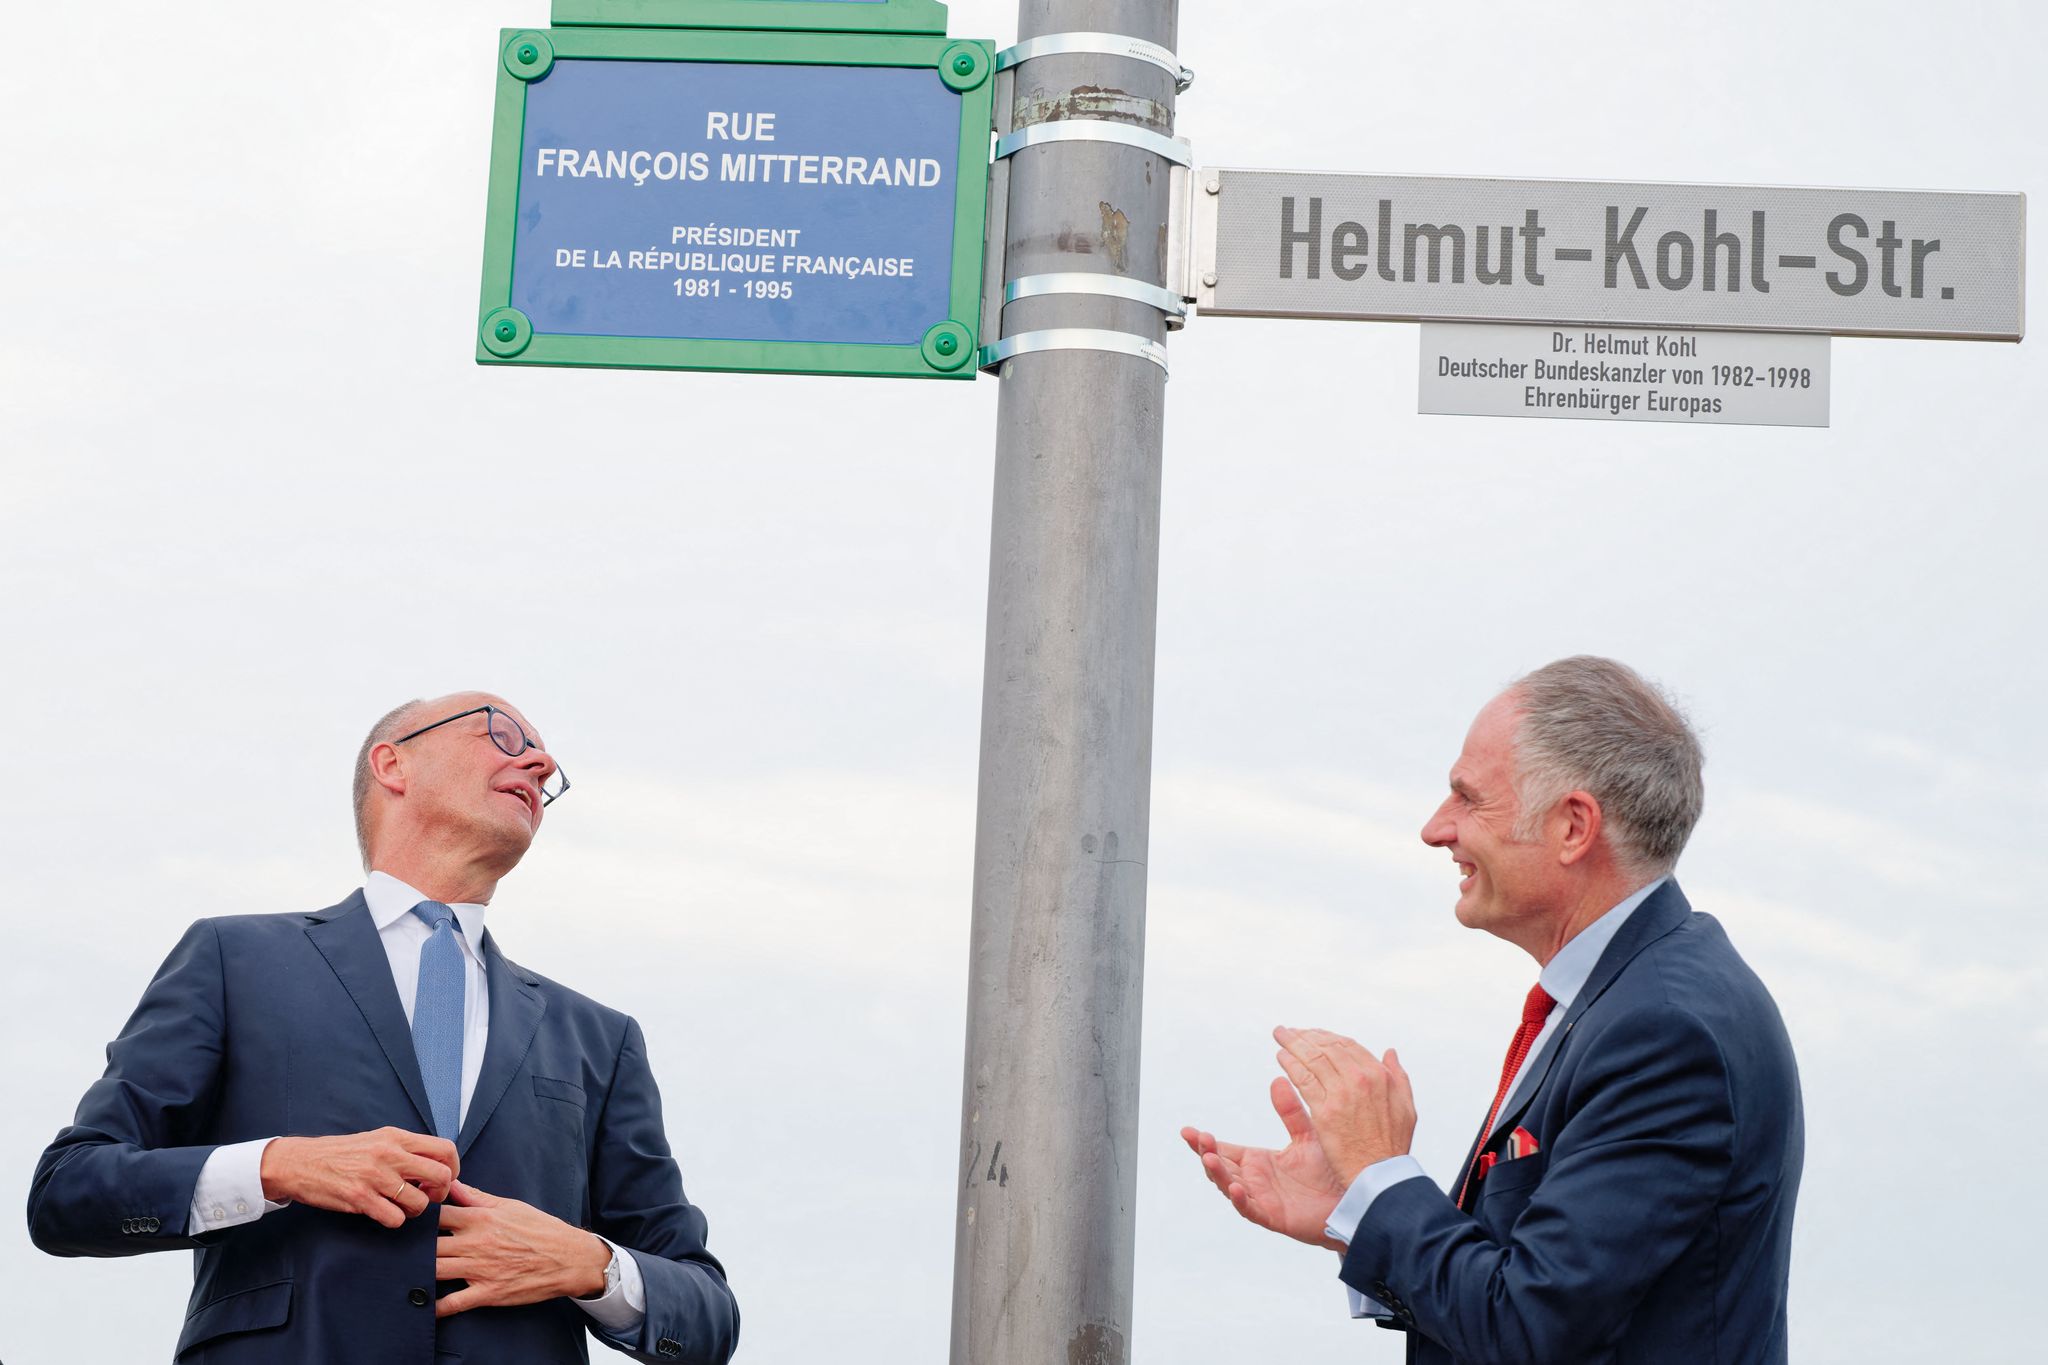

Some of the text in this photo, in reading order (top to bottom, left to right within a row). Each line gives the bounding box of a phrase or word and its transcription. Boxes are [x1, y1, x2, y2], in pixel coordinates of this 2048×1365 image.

[706, 111, 776, 142] RUE
[537, 148, 942, 187] FRANÇOIS MITTERRAND
[671, 223, 801, 248] PRÉSIDENT
[1279, 196, 1955, 301] Helmut-Kohl-Str.
[555, 247, 914, 280] DE LA RÉPUBLIQUE FRANÇAISE
[672, 278, 721, 298] 1981
[742, 280, 793, 300] 1995
[1552, 331, 1697, 358] Dr. Helmut Kohl
[1438, 355, 1811, 389] Deutscher Bundeskanzler von 1982-1998
[1525, 385, 1722, 418] Ehrenbürger Europas
